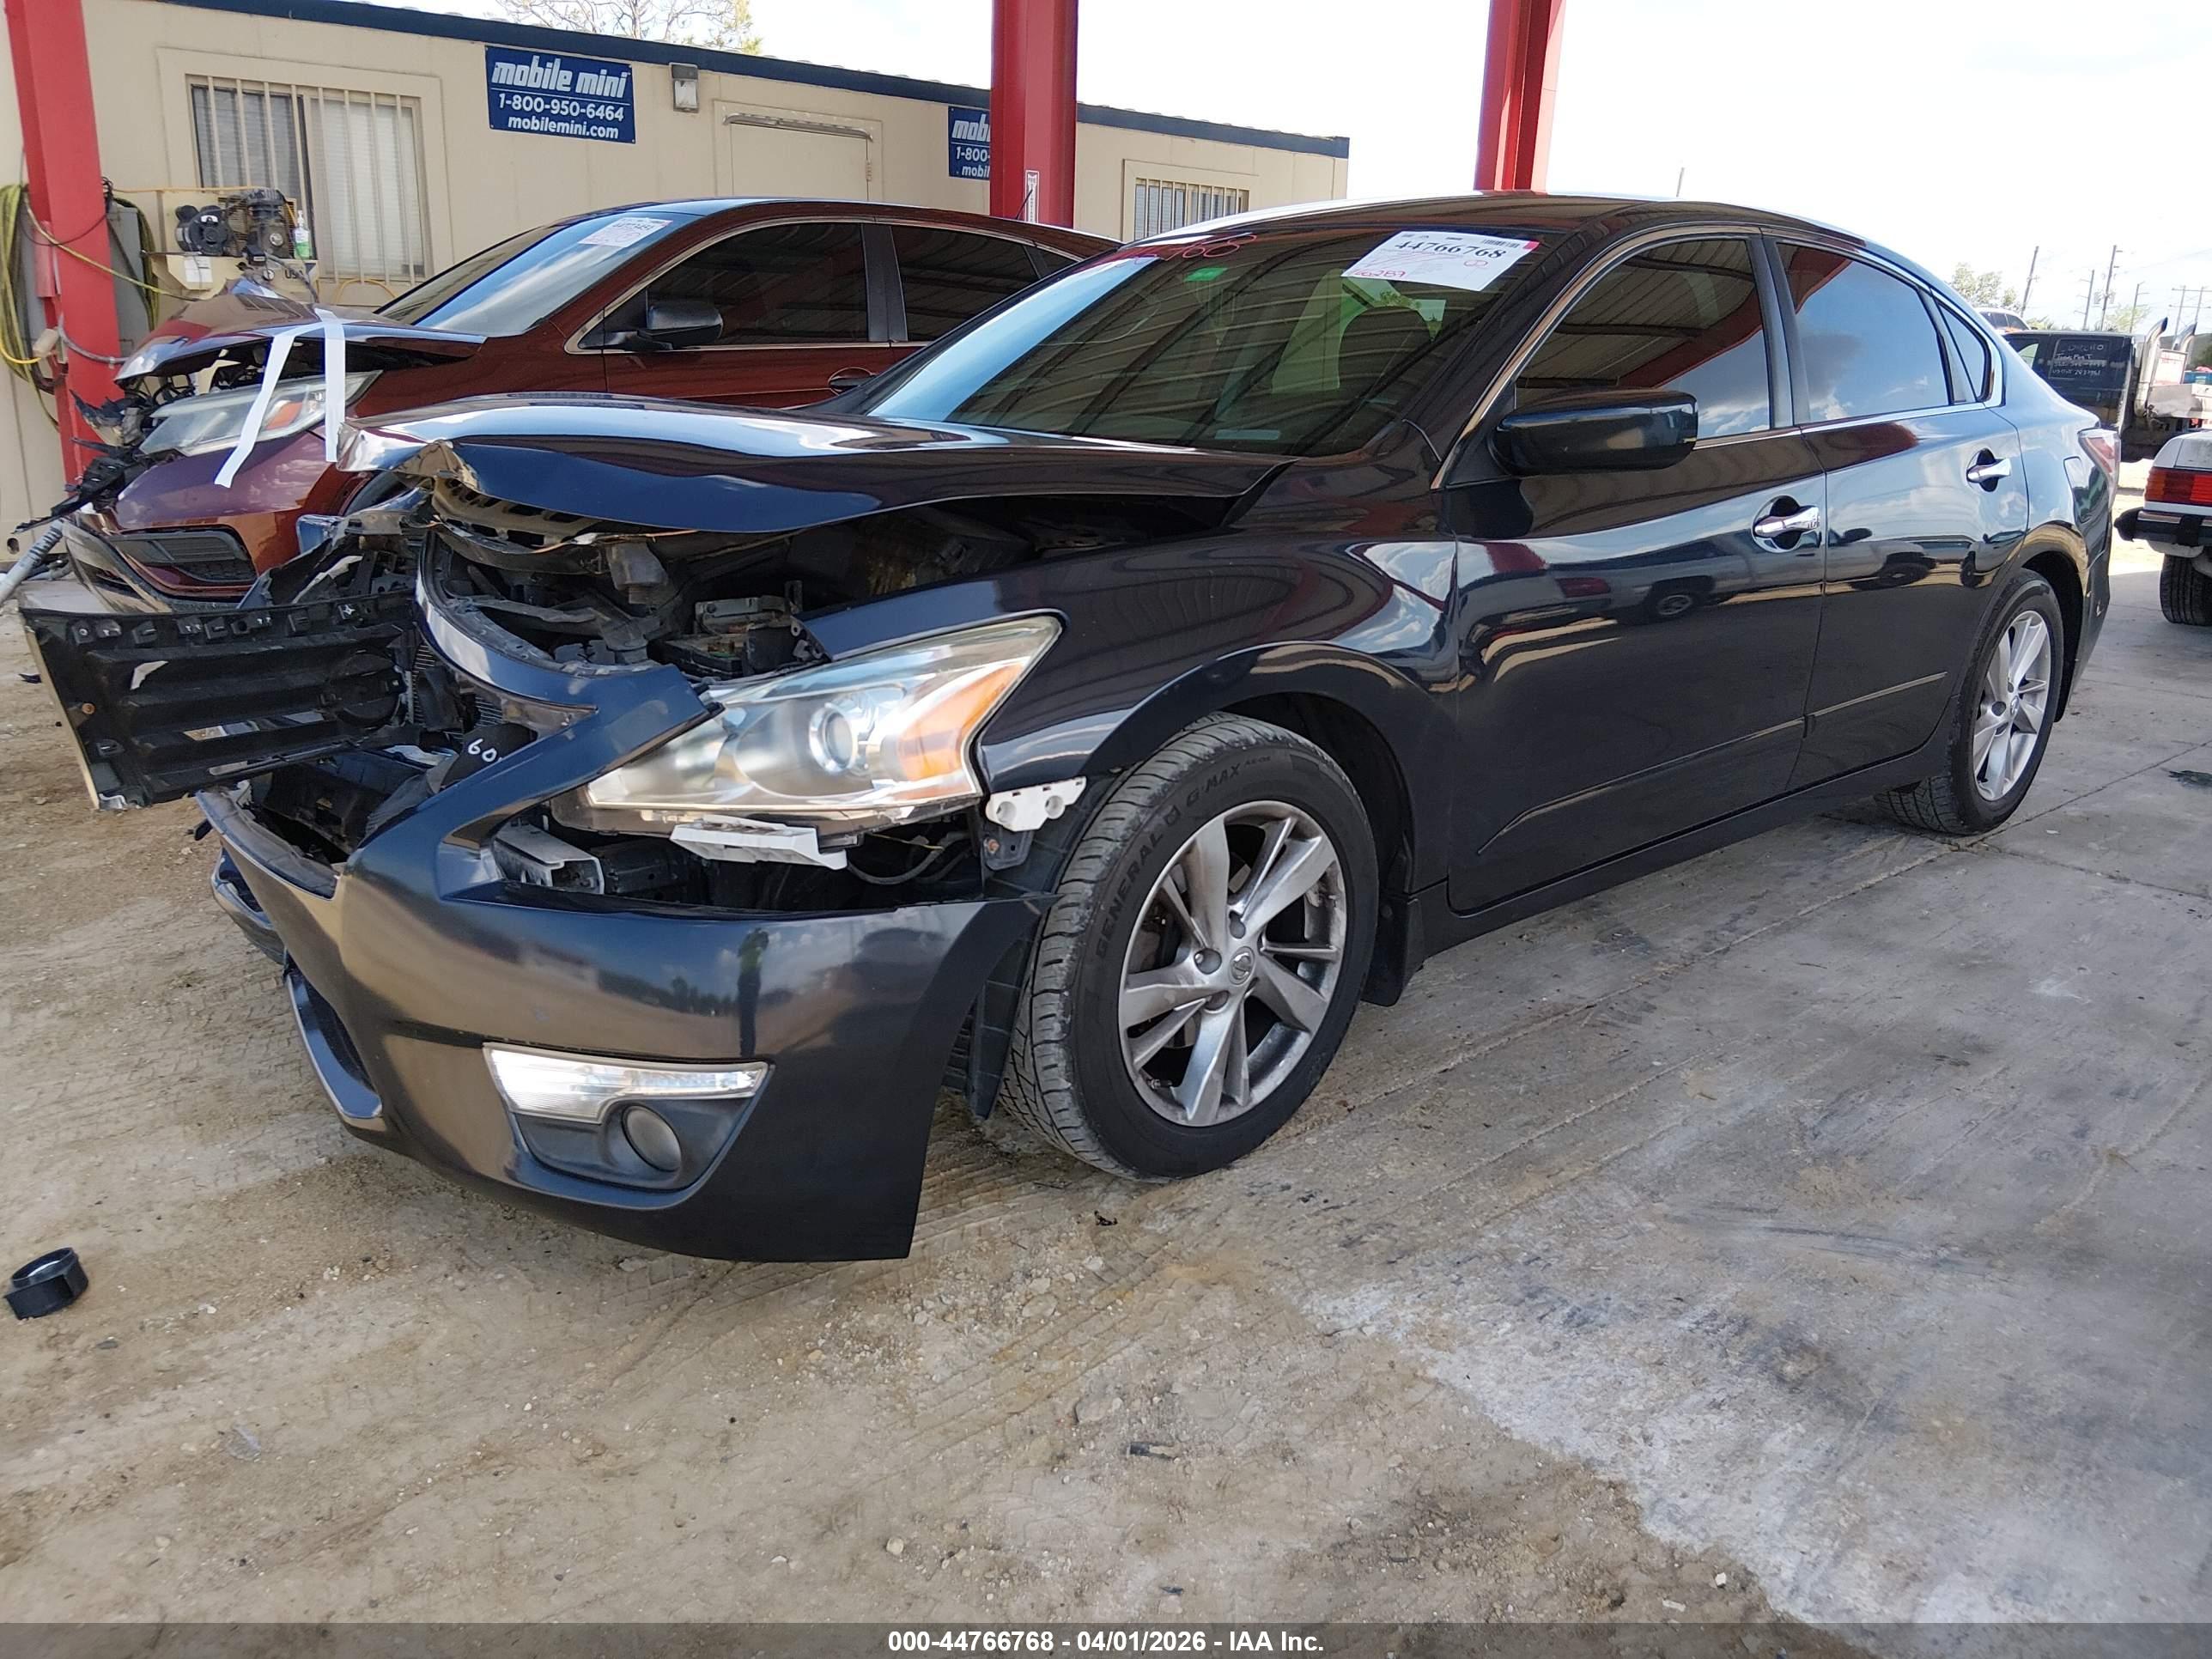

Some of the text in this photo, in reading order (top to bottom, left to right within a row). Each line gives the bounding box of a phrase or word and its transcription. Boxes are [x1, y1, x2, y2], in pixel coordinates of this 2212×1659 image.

[491, 55, 629, 98] mobile mini
[499, 93, 624, 122] 1-800-950-6464
[508, 115, 619, 139] mobilemini.com
[1394, 240, 1507, 258] 44766768
